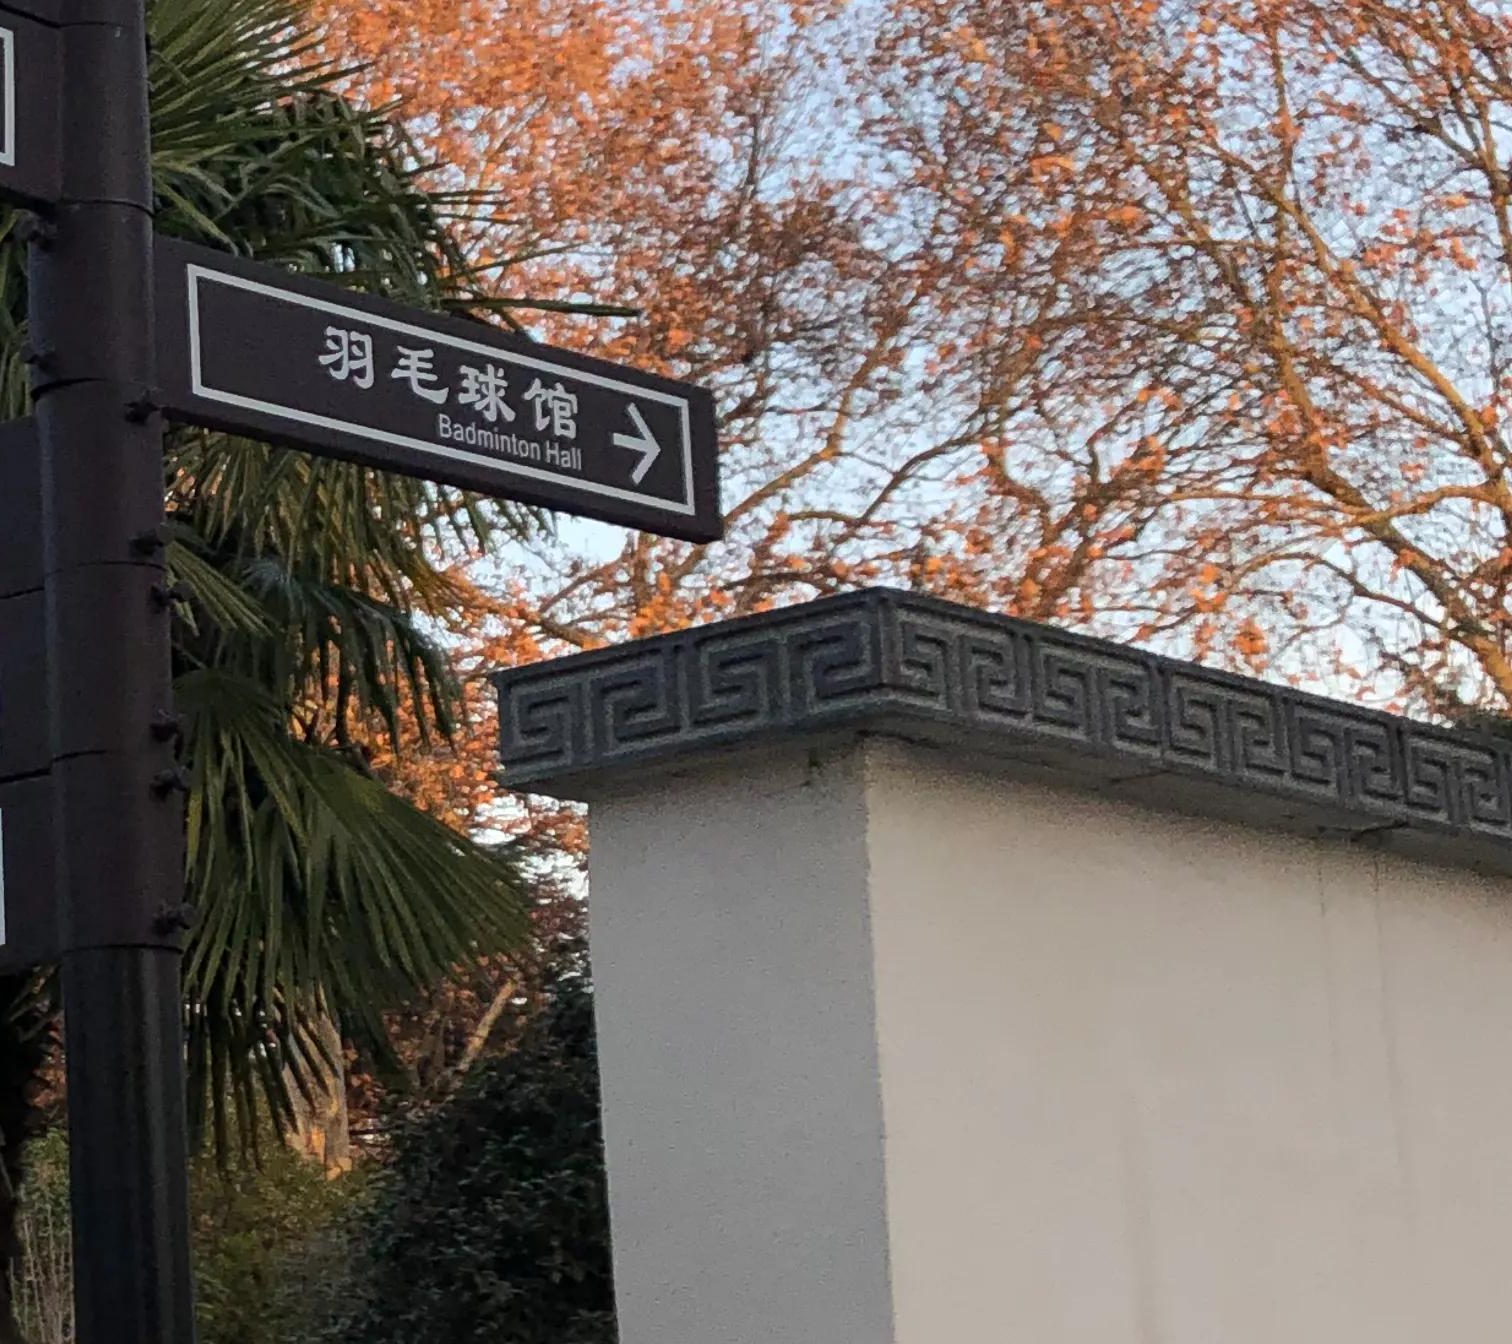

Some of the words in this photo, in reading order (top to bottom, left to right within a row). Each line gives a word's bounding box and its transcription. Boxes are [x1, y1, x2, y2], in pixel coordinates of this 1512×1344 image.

[318, 325, 578, 439] 羽毛球馆
[439, 413, 541, 460] Badminton
[545, 440, 582, 471] Hall
